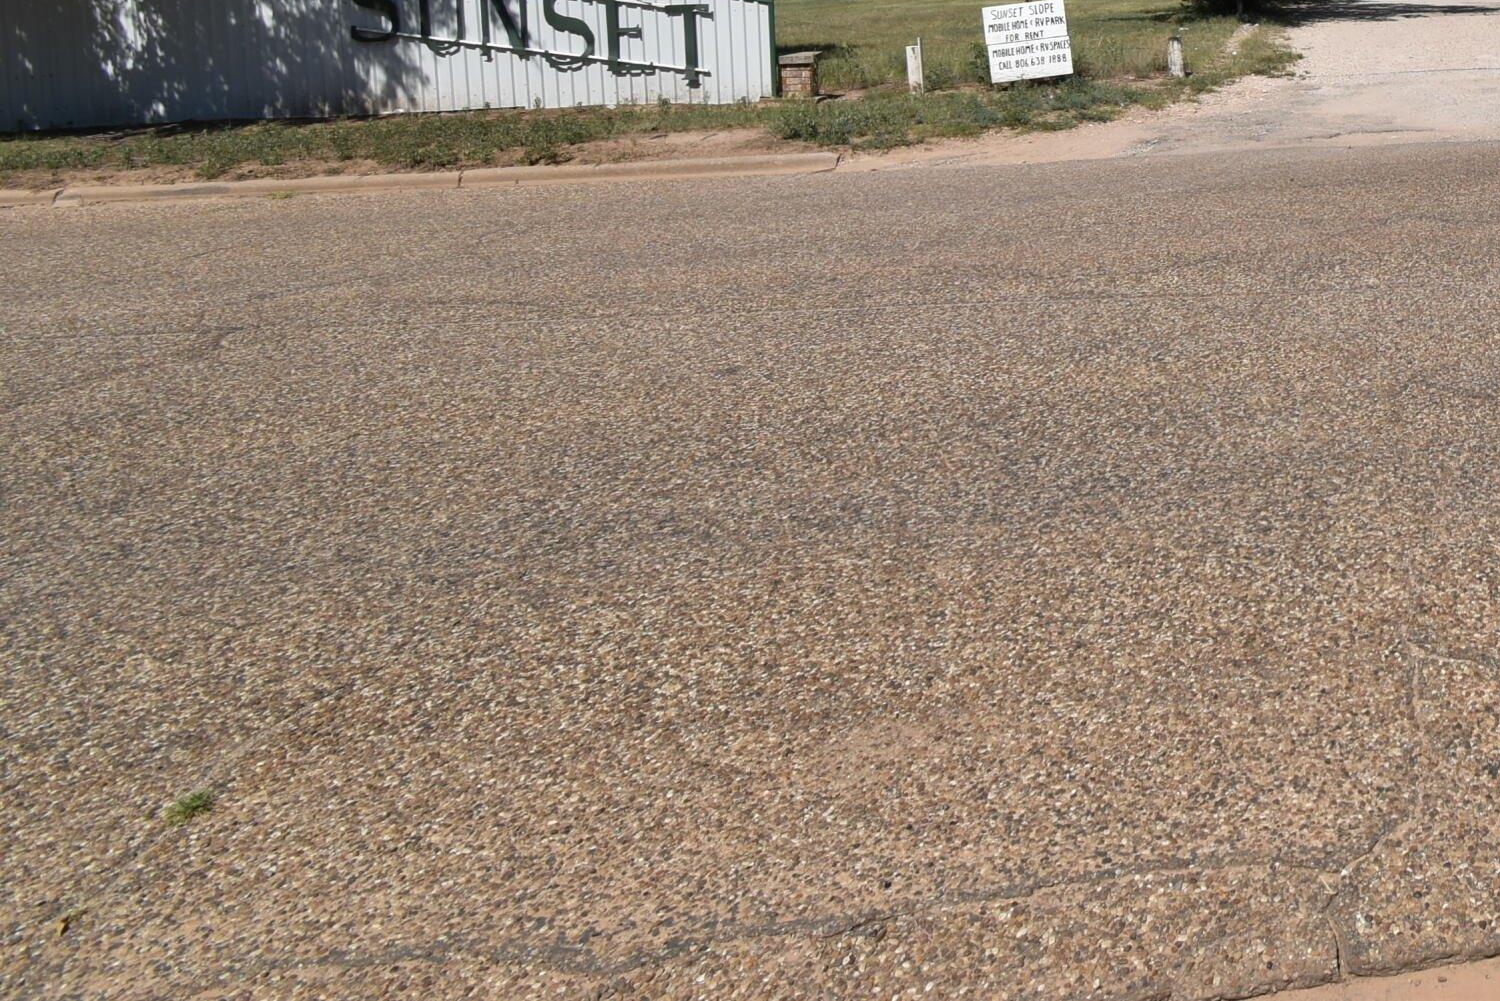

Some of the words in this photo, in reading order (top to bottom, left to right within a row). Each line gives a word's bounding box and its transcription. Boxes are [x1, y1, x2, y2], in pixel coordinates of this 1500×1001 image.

[990, 7, 1024, 20] SUNSET
[1029, 3, 1054, 16] SLOPE
[988, 22, 1010, 33] MOBILE
[1011, 19, 1028, 30] HOME
[1035, 18, 1044, 27] RV
[1045, 16, 1065, 27] PARK
[1005, 33, 1019, 43] FOR
[1025, 30, 1044, 40] RENT
[992, 47, 1015, 58] MOBILE
[1015, 44, 1035, 55] HOME
[1049, 39, 1071, 51] SPACES
[998, 60, 1013, 71] CALL
